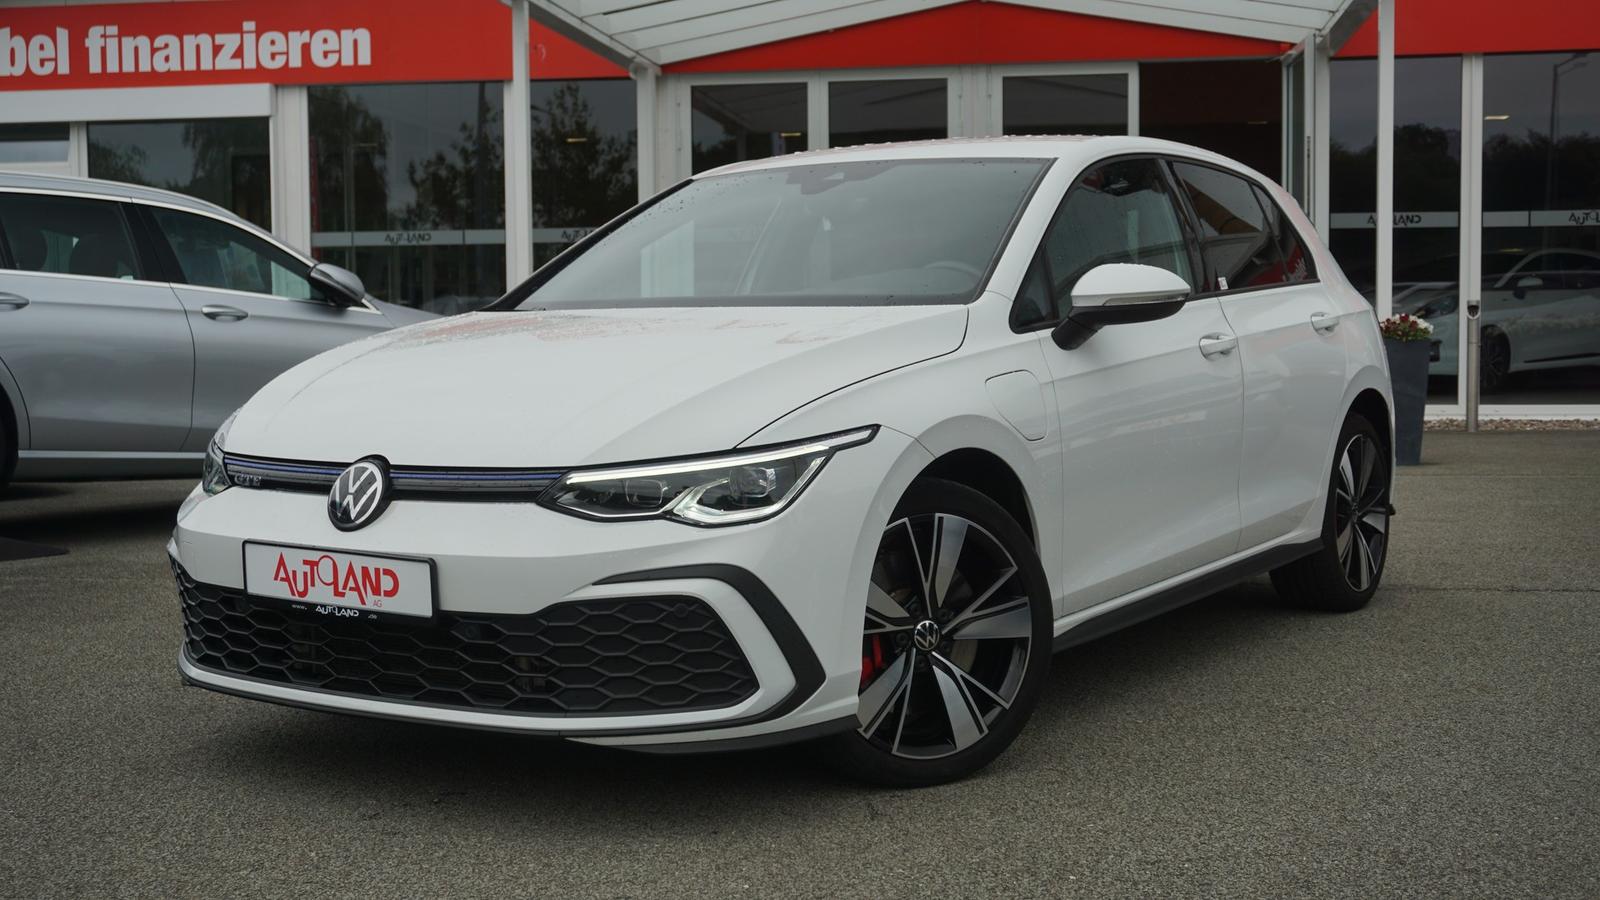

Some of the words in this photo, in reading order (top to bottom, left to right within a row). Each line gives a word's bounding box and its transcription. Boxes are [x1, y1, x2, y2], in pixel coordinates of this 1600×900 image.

[85, 21, 371, 74] finanzieren
[234, 473, 262, 486] GTE
[372, 600, 383, 608] AG
